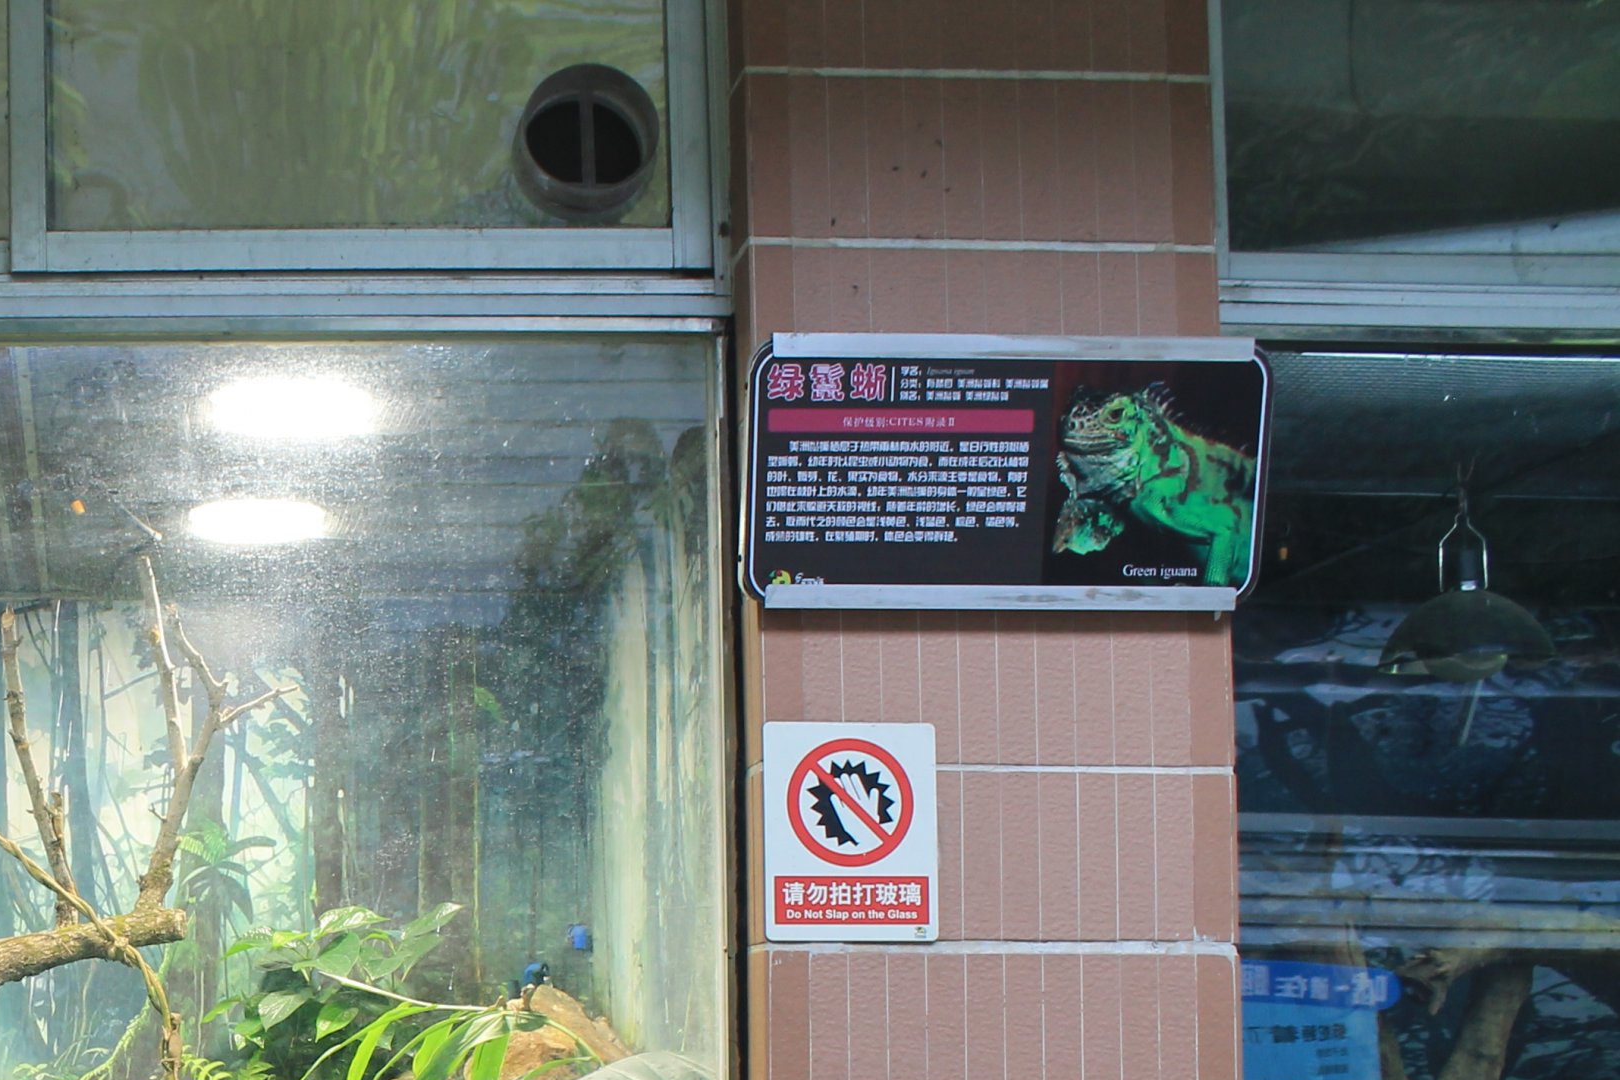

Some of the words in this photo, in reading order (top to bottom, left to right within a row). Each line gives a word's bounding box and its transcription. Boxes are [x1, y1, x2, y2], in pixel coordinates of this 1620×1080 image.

[767, 363, 887, 401] 绿鬣蜥
[1122, 564, 1157, 577] Green
[1160, 564, 1198, 580] iguana
[782, 882, 922, 906] 请勿拍打玻璃
[786, 909, 801, 919] Do
[804, 909, 823, 919] Not
[825, 909, 849, 921] Slap
[852, 911, 865, 919] on
[868, 909, 885, 919] the
[887, 909, 917, 919] Glass
